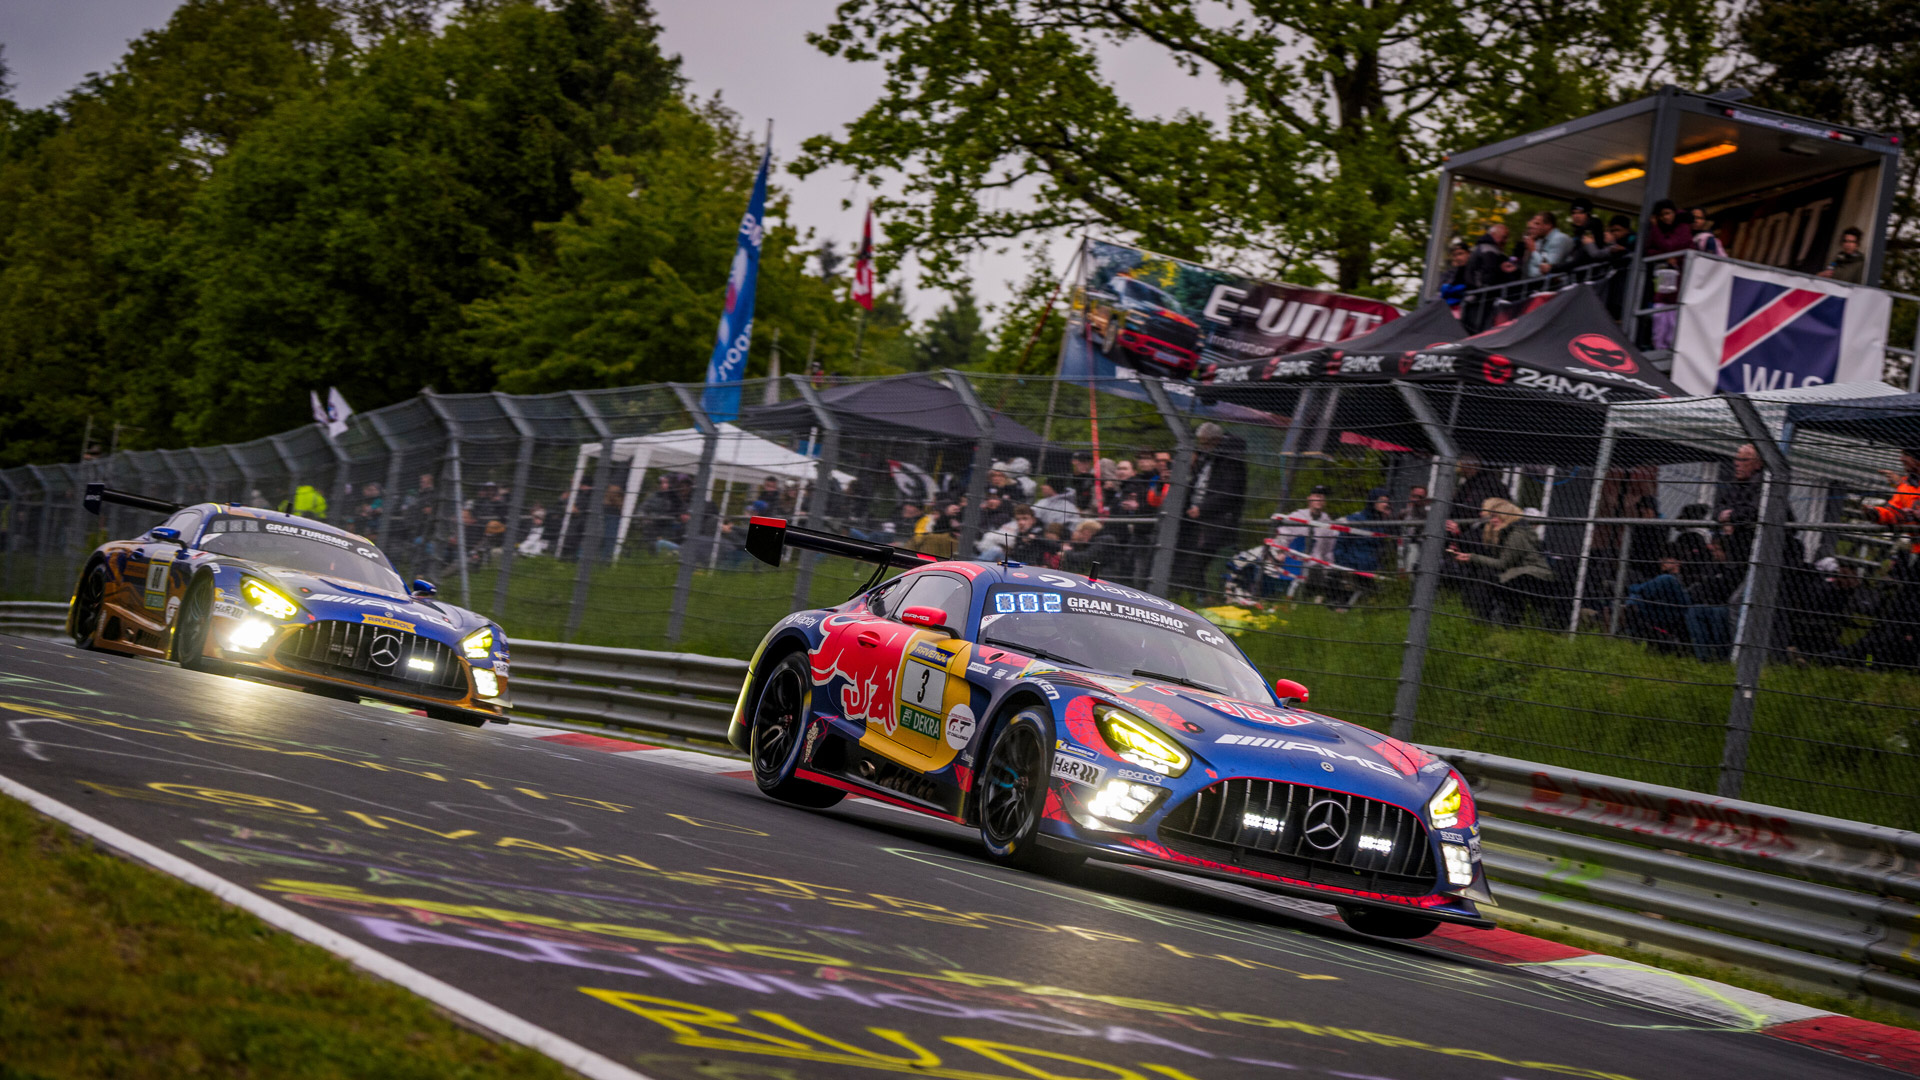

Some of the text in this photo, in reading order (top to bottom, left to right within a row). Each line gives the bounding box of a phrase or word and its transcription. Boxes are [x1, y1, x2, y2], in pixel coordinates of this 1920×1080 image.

[1513, 367, 1612, 405] 24MX
[265, 522, 299, 535] GRAN
[300, 528, 350, 547] TURISMO
[995, 593, 1062, 613] 002
[1066, 596, 1184, 630] GRAN TURISMO
[367, 616, 412, 631] RAVENOL
[1083, 608, 1109, 616] REAL
[1109, 611, 1143, 624] DRIVING
[1142, 617, 1186, 635] SIMULATOR
[914, 645, 951, 664] RAVENOL
[916, 668, 930, 704] 3
[912, 711, 941, 740] DEKRA
[1118, 768, 1162, 783] sparco
